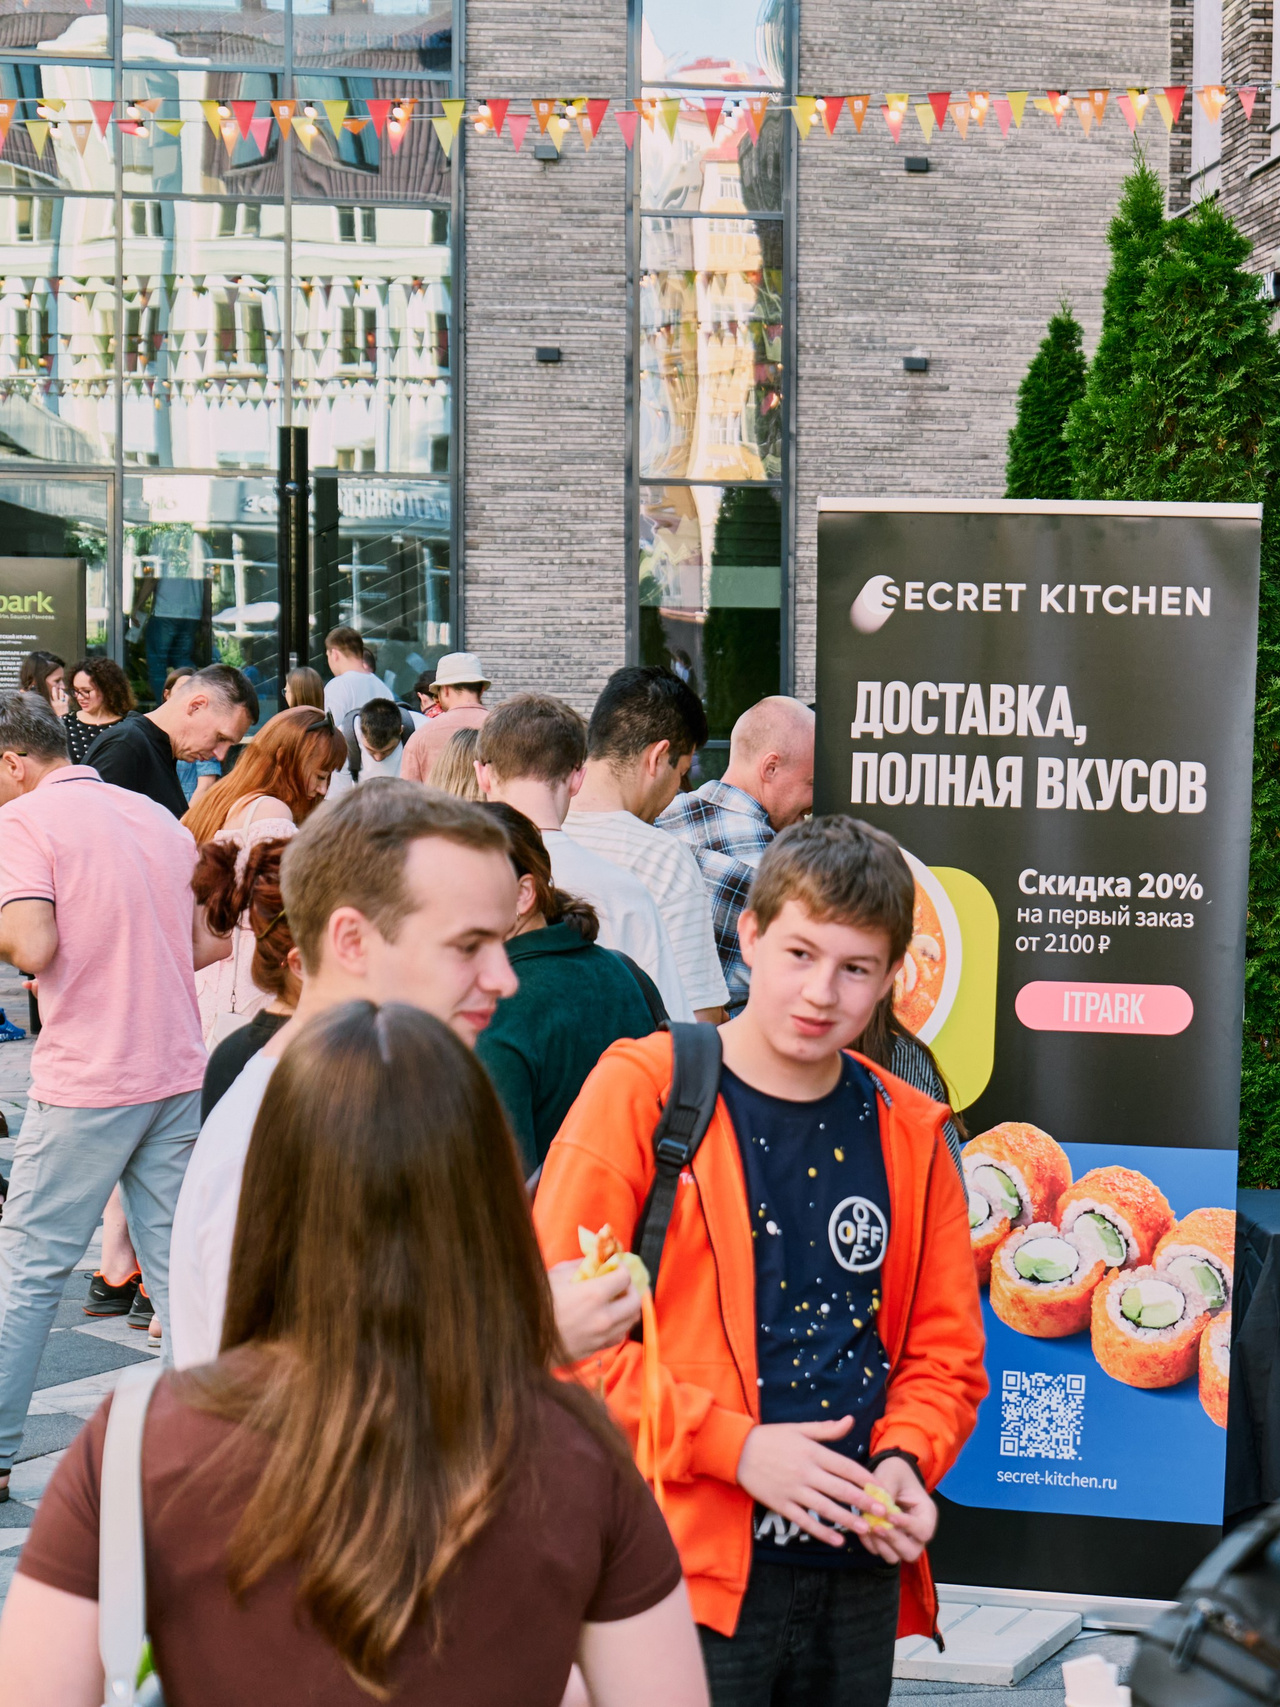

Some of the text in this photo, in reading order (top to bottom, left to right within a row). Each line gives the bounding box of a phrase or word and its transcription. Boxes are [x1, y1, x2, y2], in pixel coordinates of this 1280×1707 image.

[881, 580, 1211, 617] SECRET KITCHEN
[851, 681, 1087, 746] ДОСТАВКА,
[851, 752, 1207, 814] ПОЛНАЯ ВКУСОВ
[1018, 868, 1204, 902] Скидка 20%
[1017, 904, 1195, 929] на первый заказ
[1015, 935, 1041, 952] от
[1044, 933, 1095, 954] 2100
[1062, 991, 1145, 1024] ITPARK
[996, 1470, 1117, 1490] secret-kitchen.ru
